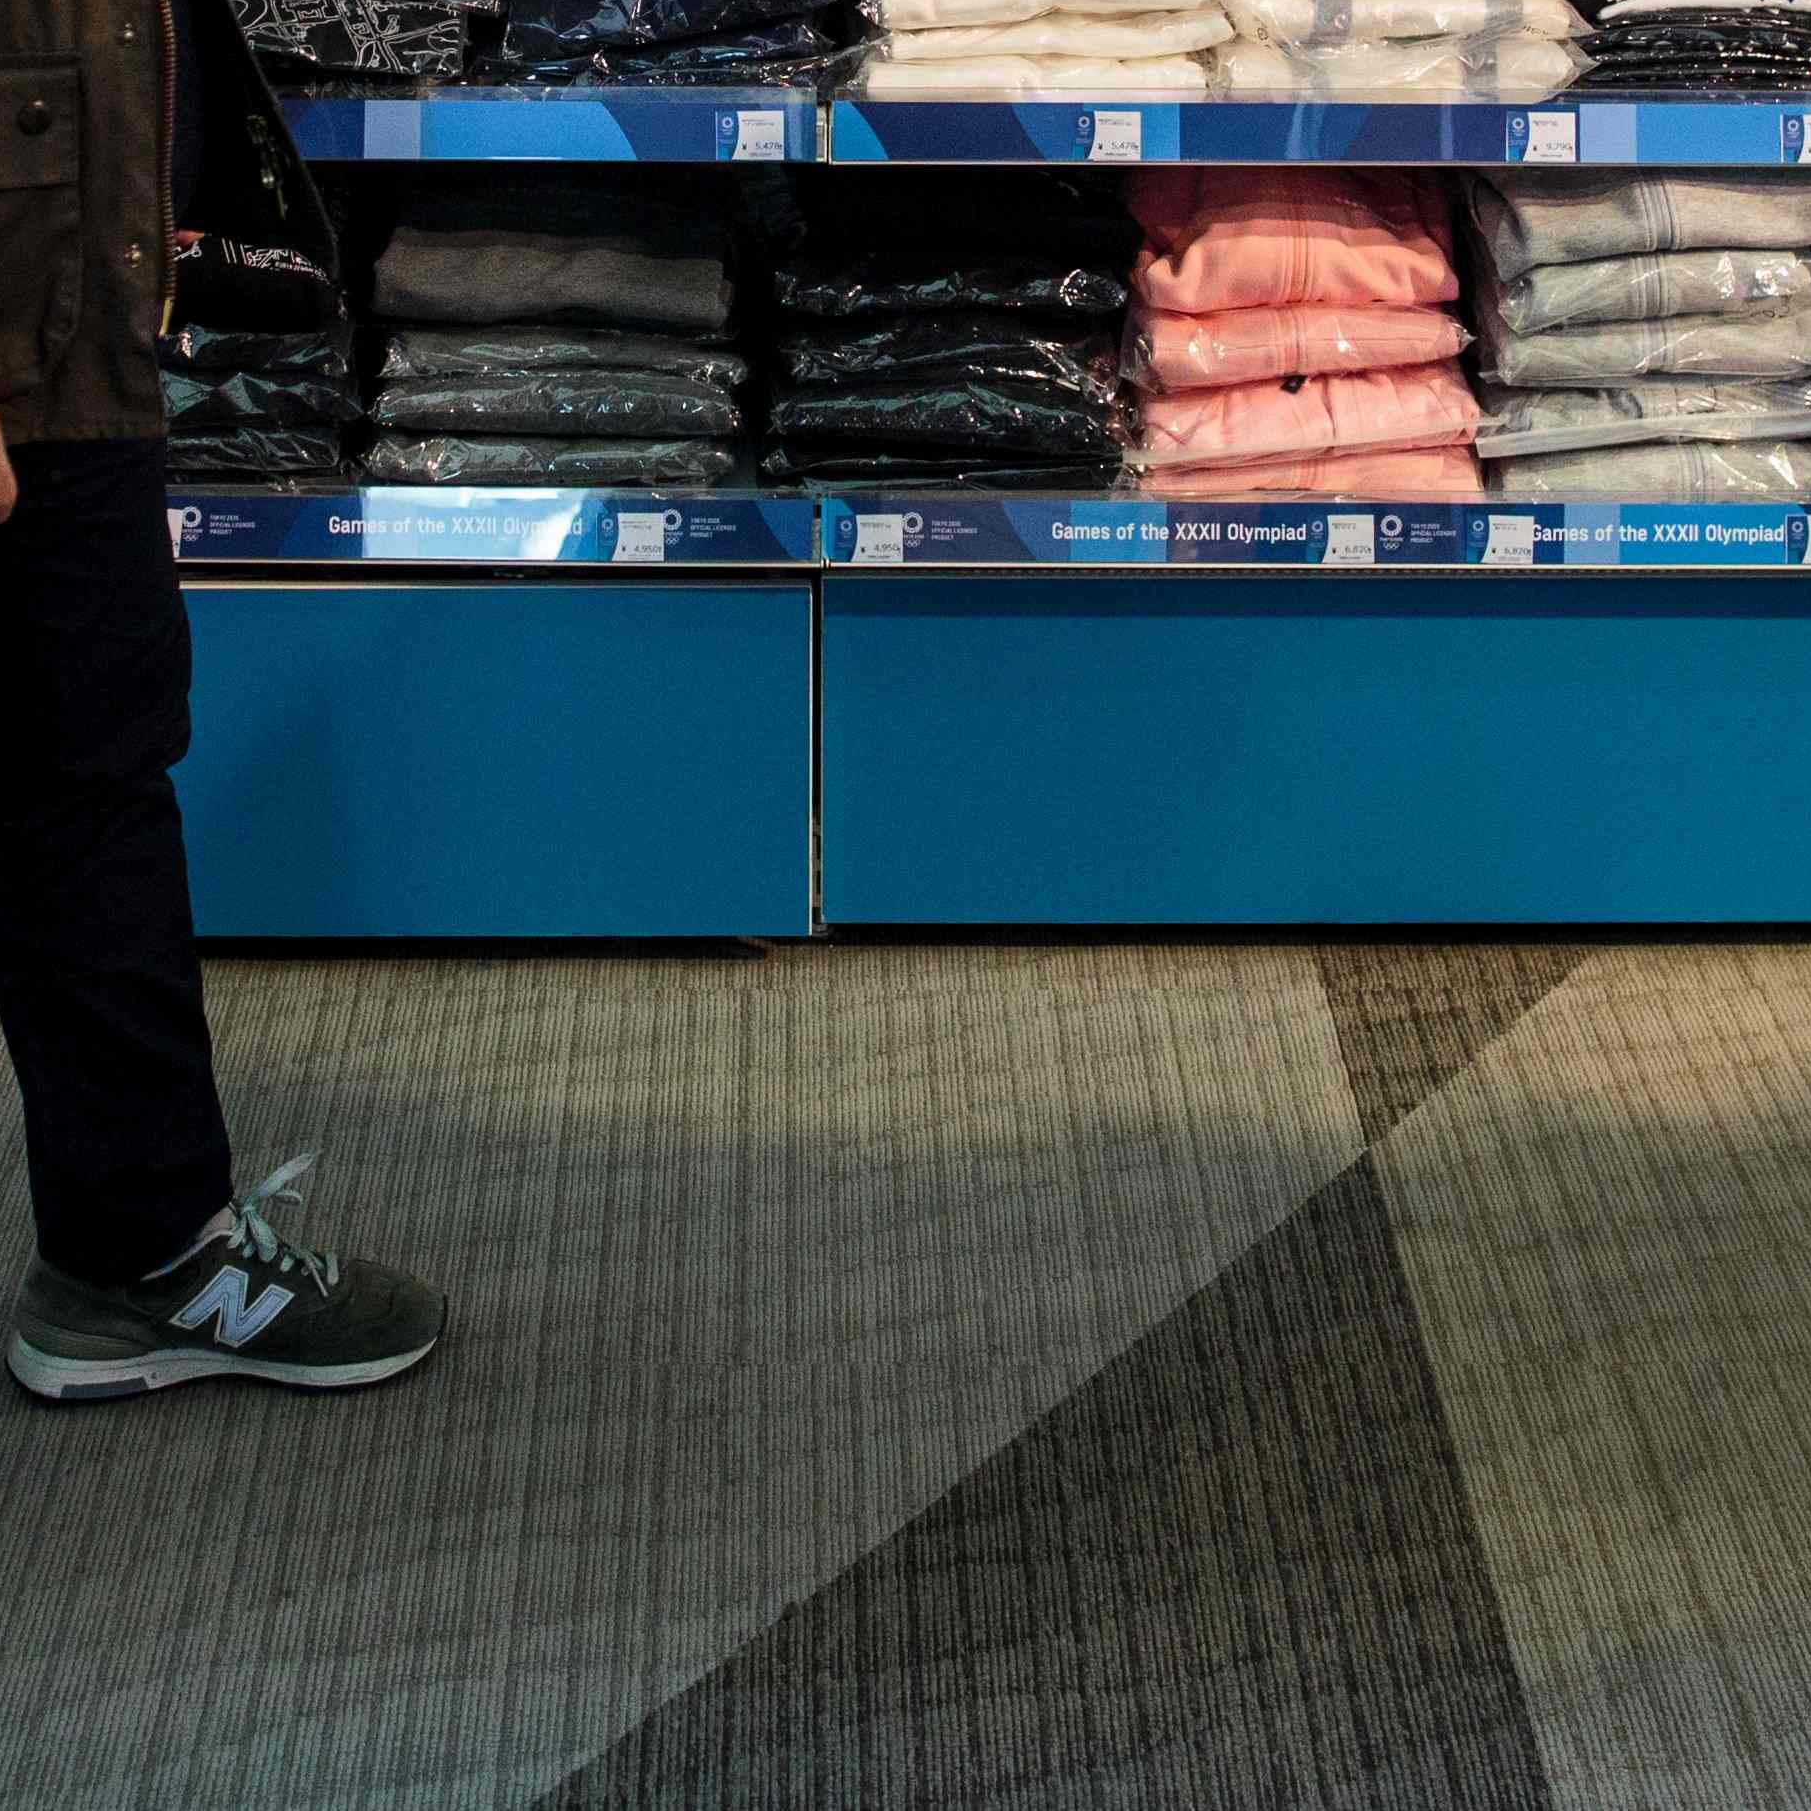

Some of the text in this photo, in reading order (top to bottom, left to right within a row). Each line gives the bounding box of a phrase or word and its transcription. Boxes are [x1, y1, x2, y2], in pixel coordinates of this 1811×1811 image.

[329, 516, 497, 534] Games of the XXXII
[1051, 522, 1306, 545] Games of the XXXII Olympiad
[1532, 523, 1589, 542] Games
[1595, 523, 1614, 542] of
[1619, 523, 1648, 542] the
[1653, 523, 1699, 542] XXXII
[1705, 523, 1784, 547] Olympiad
[169, 1265, 296, 1348] N
